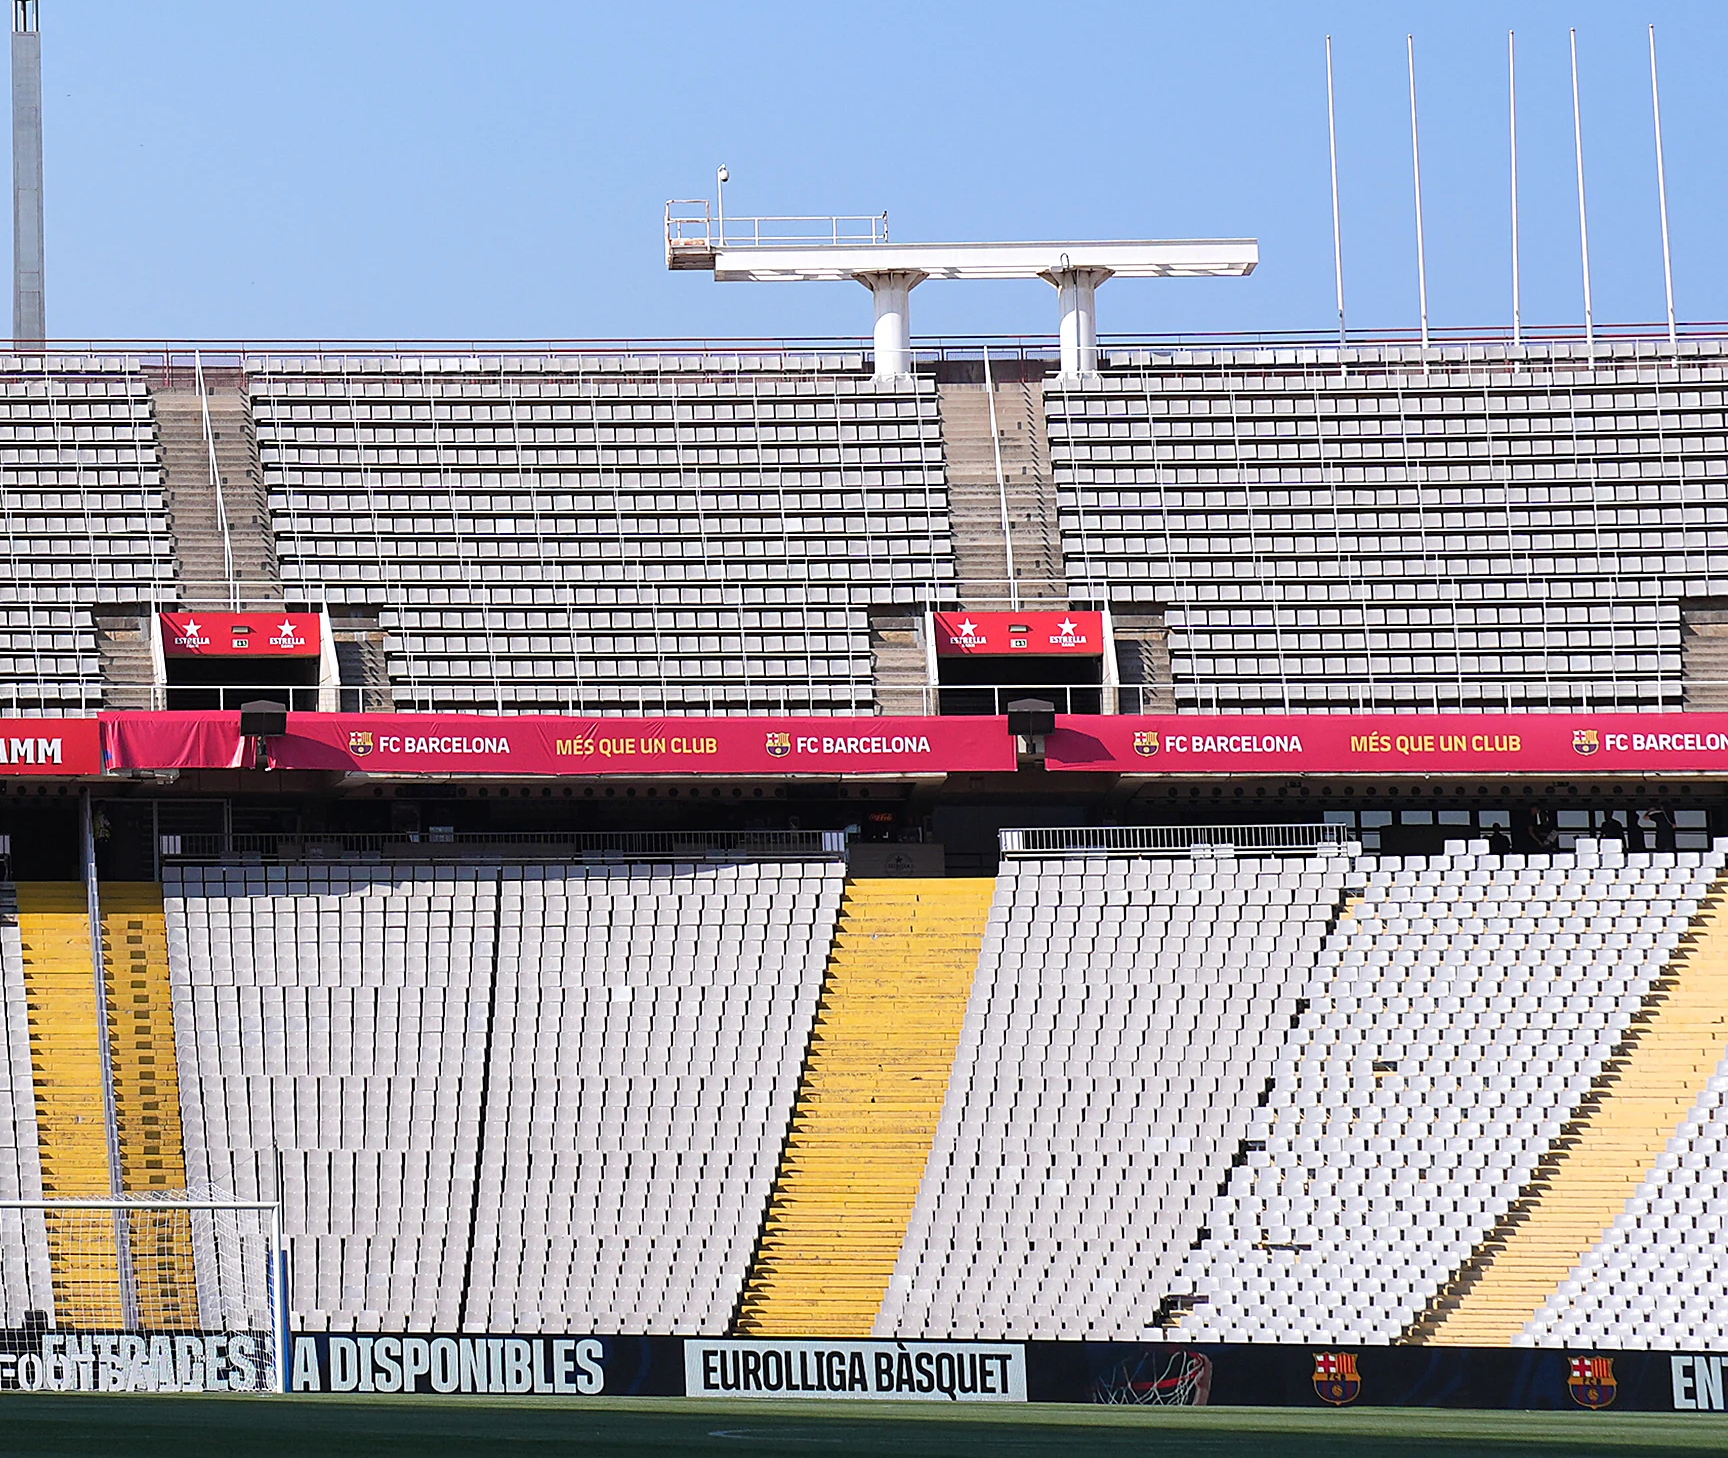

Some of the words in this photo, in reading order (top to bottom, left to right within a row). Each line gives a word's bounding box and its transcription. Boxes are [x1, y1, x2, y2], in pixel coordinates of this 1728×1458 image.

[270, 637, 305, 645] ESTRELLA
[950, 635, 987, 644] ESTRELLA
[1049, 635, 1086, 644] ESTRELLA
[379, 736, 401, 753] FC
[405, 736, 510, 753] BARCELONA
[556, 734, 594, 755] MÉS
[599, 738, 636, 758] QUE
[640, 737, 666, 754] UN
[670, 737, 718, 754] CLUB
[796, 737, 819, 753] FC
[823, 736, 931, 754] BARCELONA
[1165, 736, 1188, 753] FC
[1192, 735, 1303, 753] BARCELONA
[1350, 731, 1391, 752] MÉS
[1396, 735, 1435, 755] QUE
[1439, 735, 1467, 752] UN
[1471, 734, 1521, 752] CLUB
[1605, 734, 1629, 750] FC
[330, 1336, 605, 1394] DISPONIBLES
[702, 1349, 868, 1392] EUROLLIGA
[875, 1342, 1012, 1401] BÀSQUET
[1671, 1355, 1728, 1410] EN
